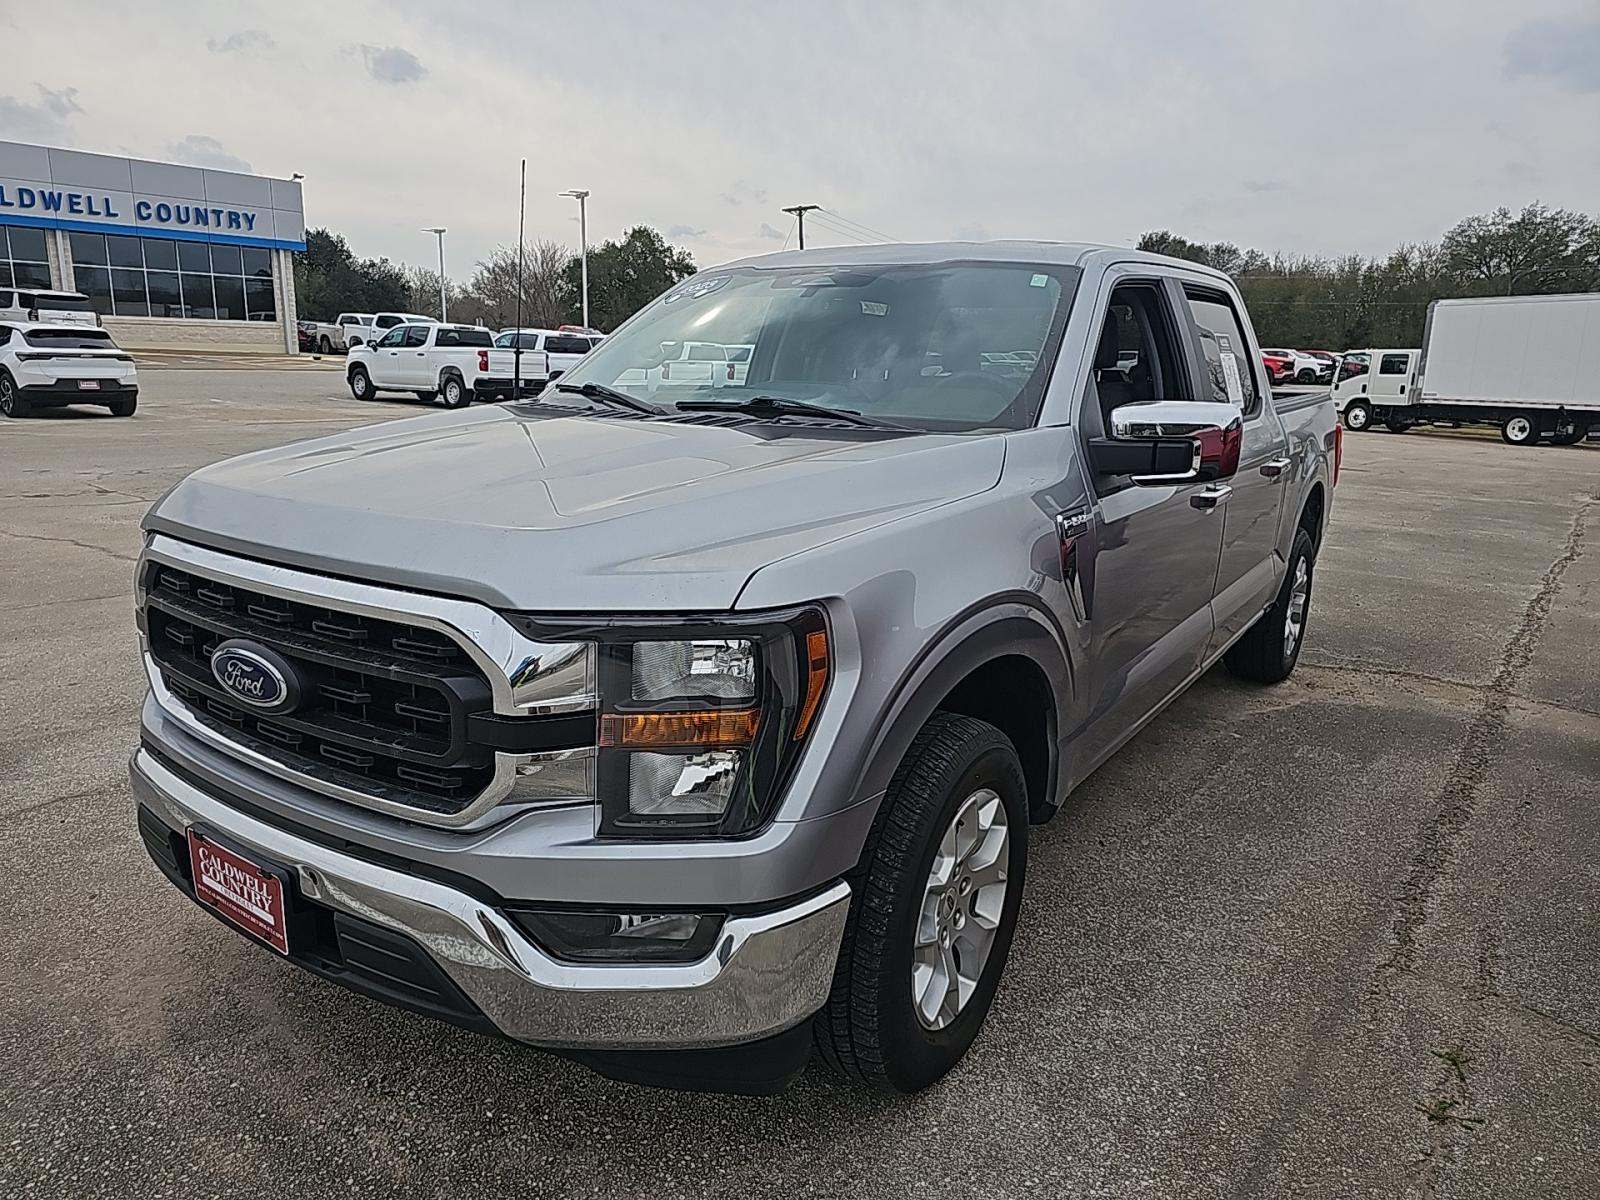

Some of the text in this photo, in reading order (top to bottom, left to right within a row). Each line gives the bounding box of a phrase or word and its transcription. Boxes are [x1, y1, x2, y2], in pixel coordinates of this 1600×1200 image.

[136, 201, 257, 231] COUNTRY
[225, 659, 264, 697] Ford
[198, 847, 273, 899] CALDWELL
[200, 861, 272, 913] COUNTRY
